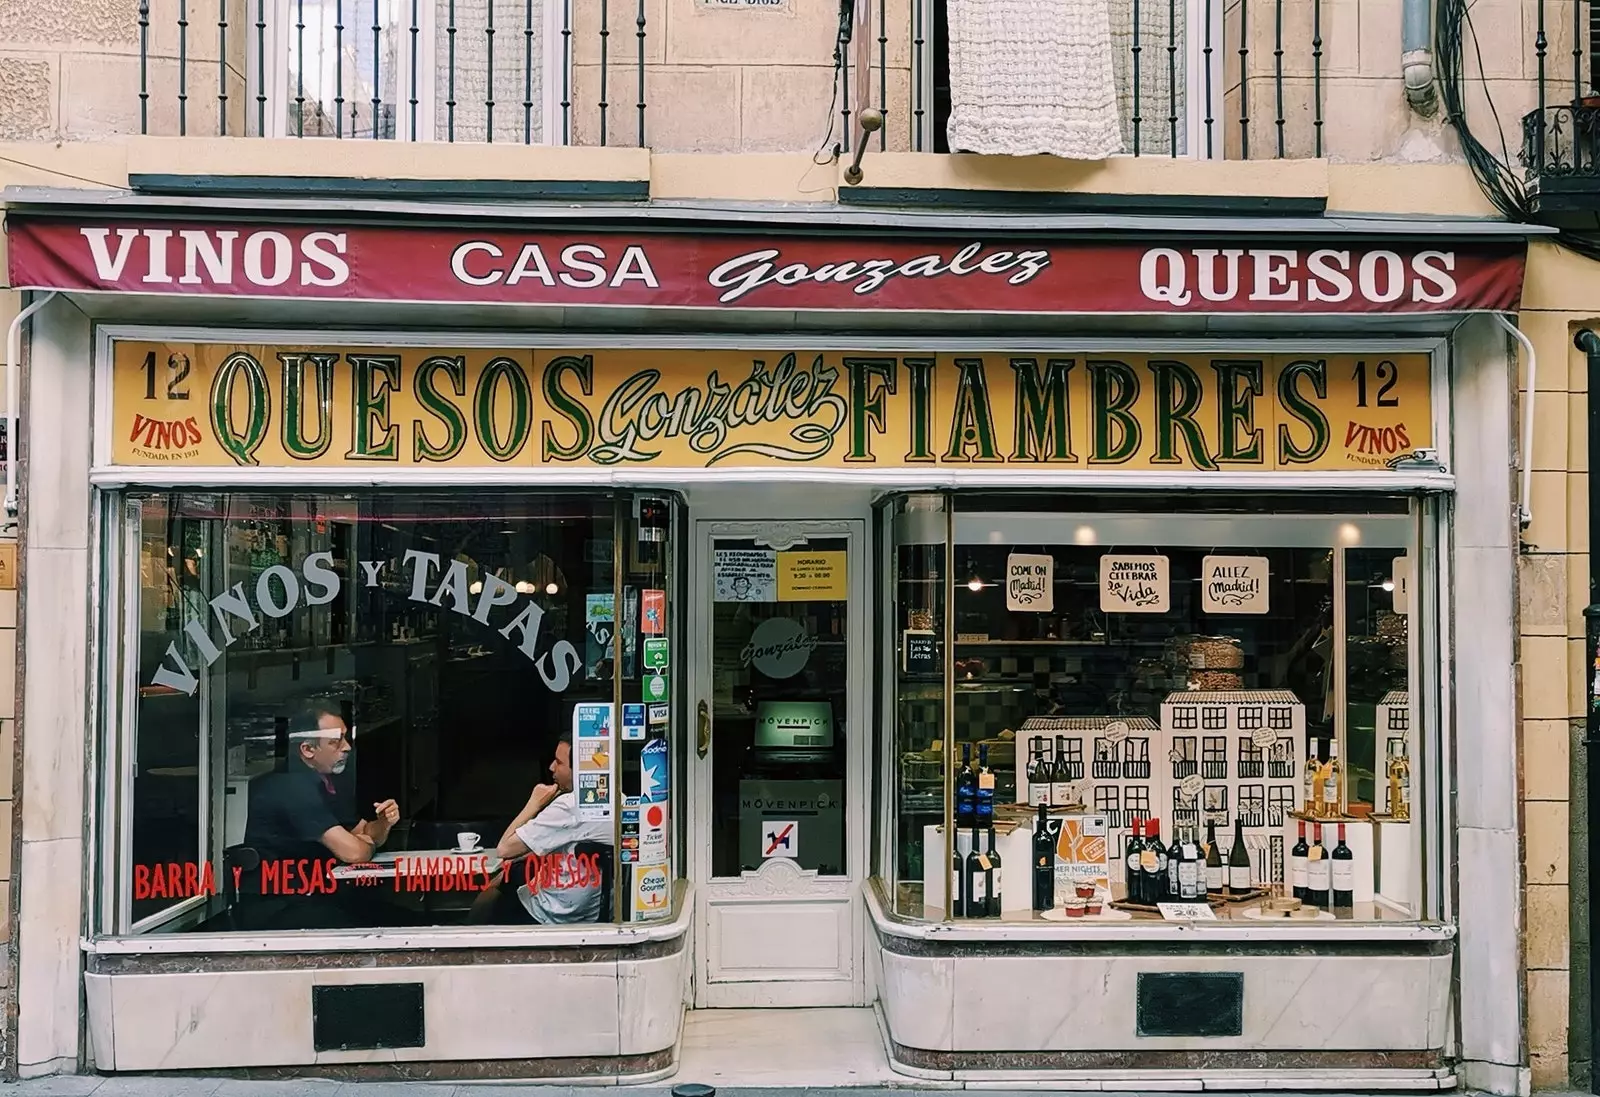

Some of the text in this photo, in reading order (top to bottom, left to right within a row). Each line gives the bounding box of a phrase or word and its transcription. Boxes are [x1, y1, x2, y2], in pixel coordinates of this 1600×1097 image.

[80, 227, 349, 288] VINOS
[450, 241, 1051, 303] CASA Gonzalez
[1140, 248, 1458, 306] QUESOS
[140, 351, 191, 400] 12
[1351, 360, 1399, 407] 12
[209, 351, 1330, 471] QUESOS González FIAMBRES
[130, 413, 202, 450] VINOS
[1344, 420, 1411, 455] VINOS
[131, 447, 169, 461] FUNDADA
[171, 452, 182, 460] EN
[1346, 453, 1382, 465] FUNDADA
[1011, 565, 1047, 576] COME ON
[1109, 572, 1158, 582] CELEBRAR
[1112, 562, 1156, 572] SABEMOS
[1212, 566, 1250, 579] ALLEZ
[1010, 578, 1046, 600] Madrid!
[1117, 584, 1157, 603] Vida
[1209, 578, 1260, 601] Madrid!
[150, 548, 583, 697] VINOS Y TAPAS
[653, 709, 668, 718] VISA
[646, 833, 663, 841] Ticket
[135, 858, 337, 900] BARRA Y MESAS
[394, 852, 601, 895] FIAMBRES Y QUESOS
[642, 876, 666, 885] Cheque
